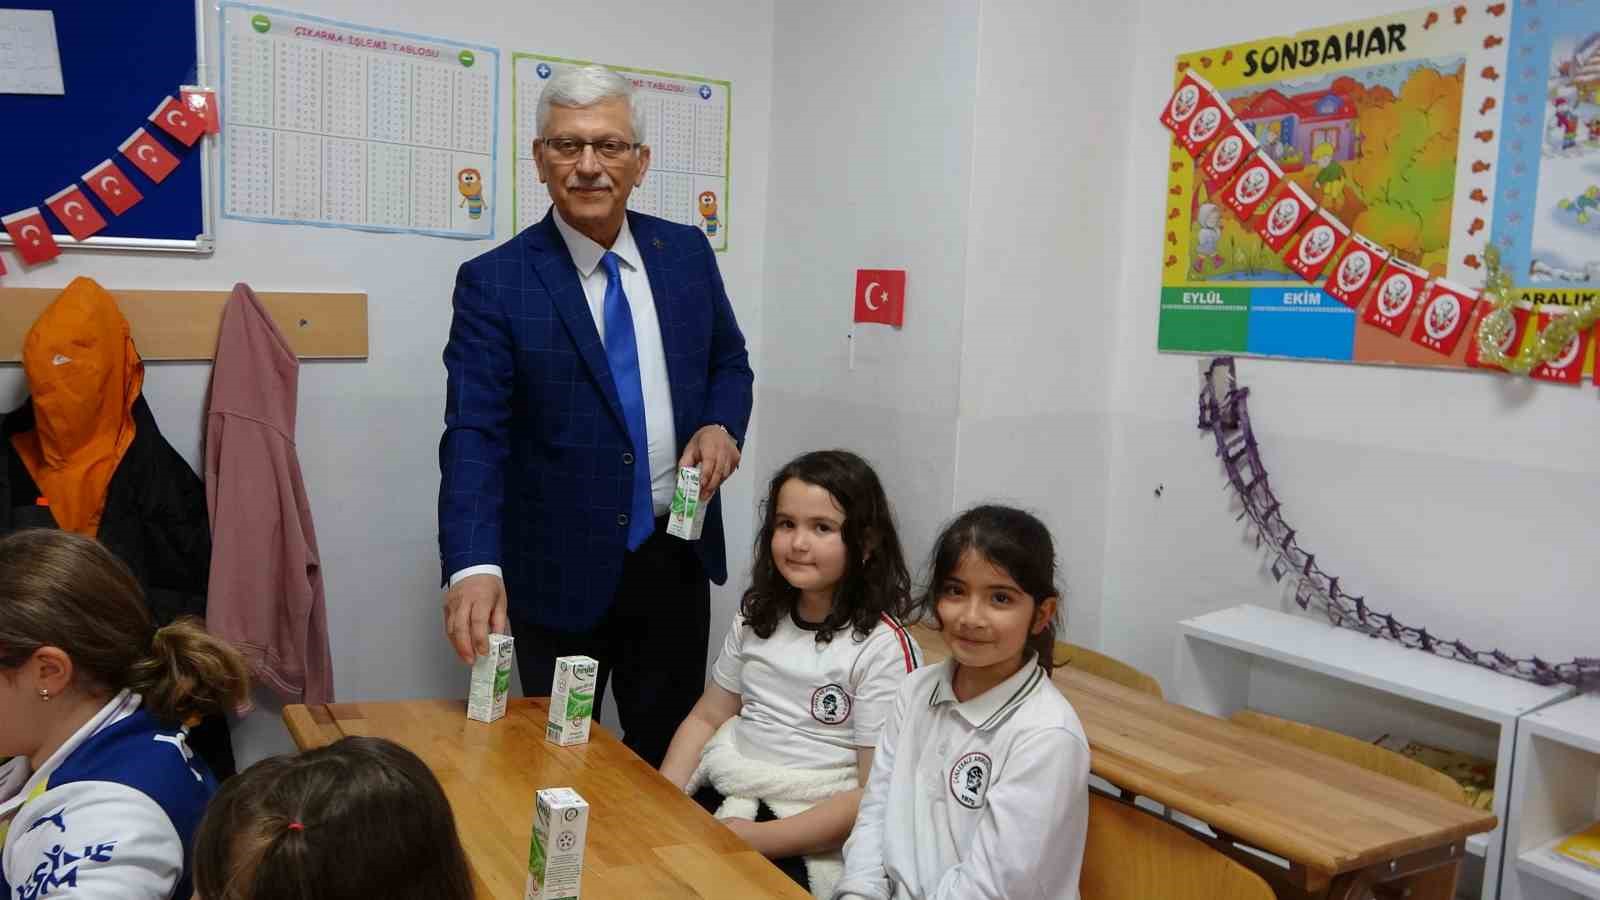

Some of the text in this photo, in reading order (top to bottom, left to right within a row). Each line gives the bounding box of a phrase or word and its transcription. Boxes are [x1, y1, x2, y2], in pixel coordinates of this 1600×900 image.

[294, 26, 344, 43] ÇIKARMA
[392, 43, 440, 58] TABLOSU
[1242, 23, 1407, 77] SONBAHAR
[1183, 290, 1224, 305] EYLÜL
[1282, 290, 1321, 306] EKİM
[1541, 367, 1567, 378] ATA
